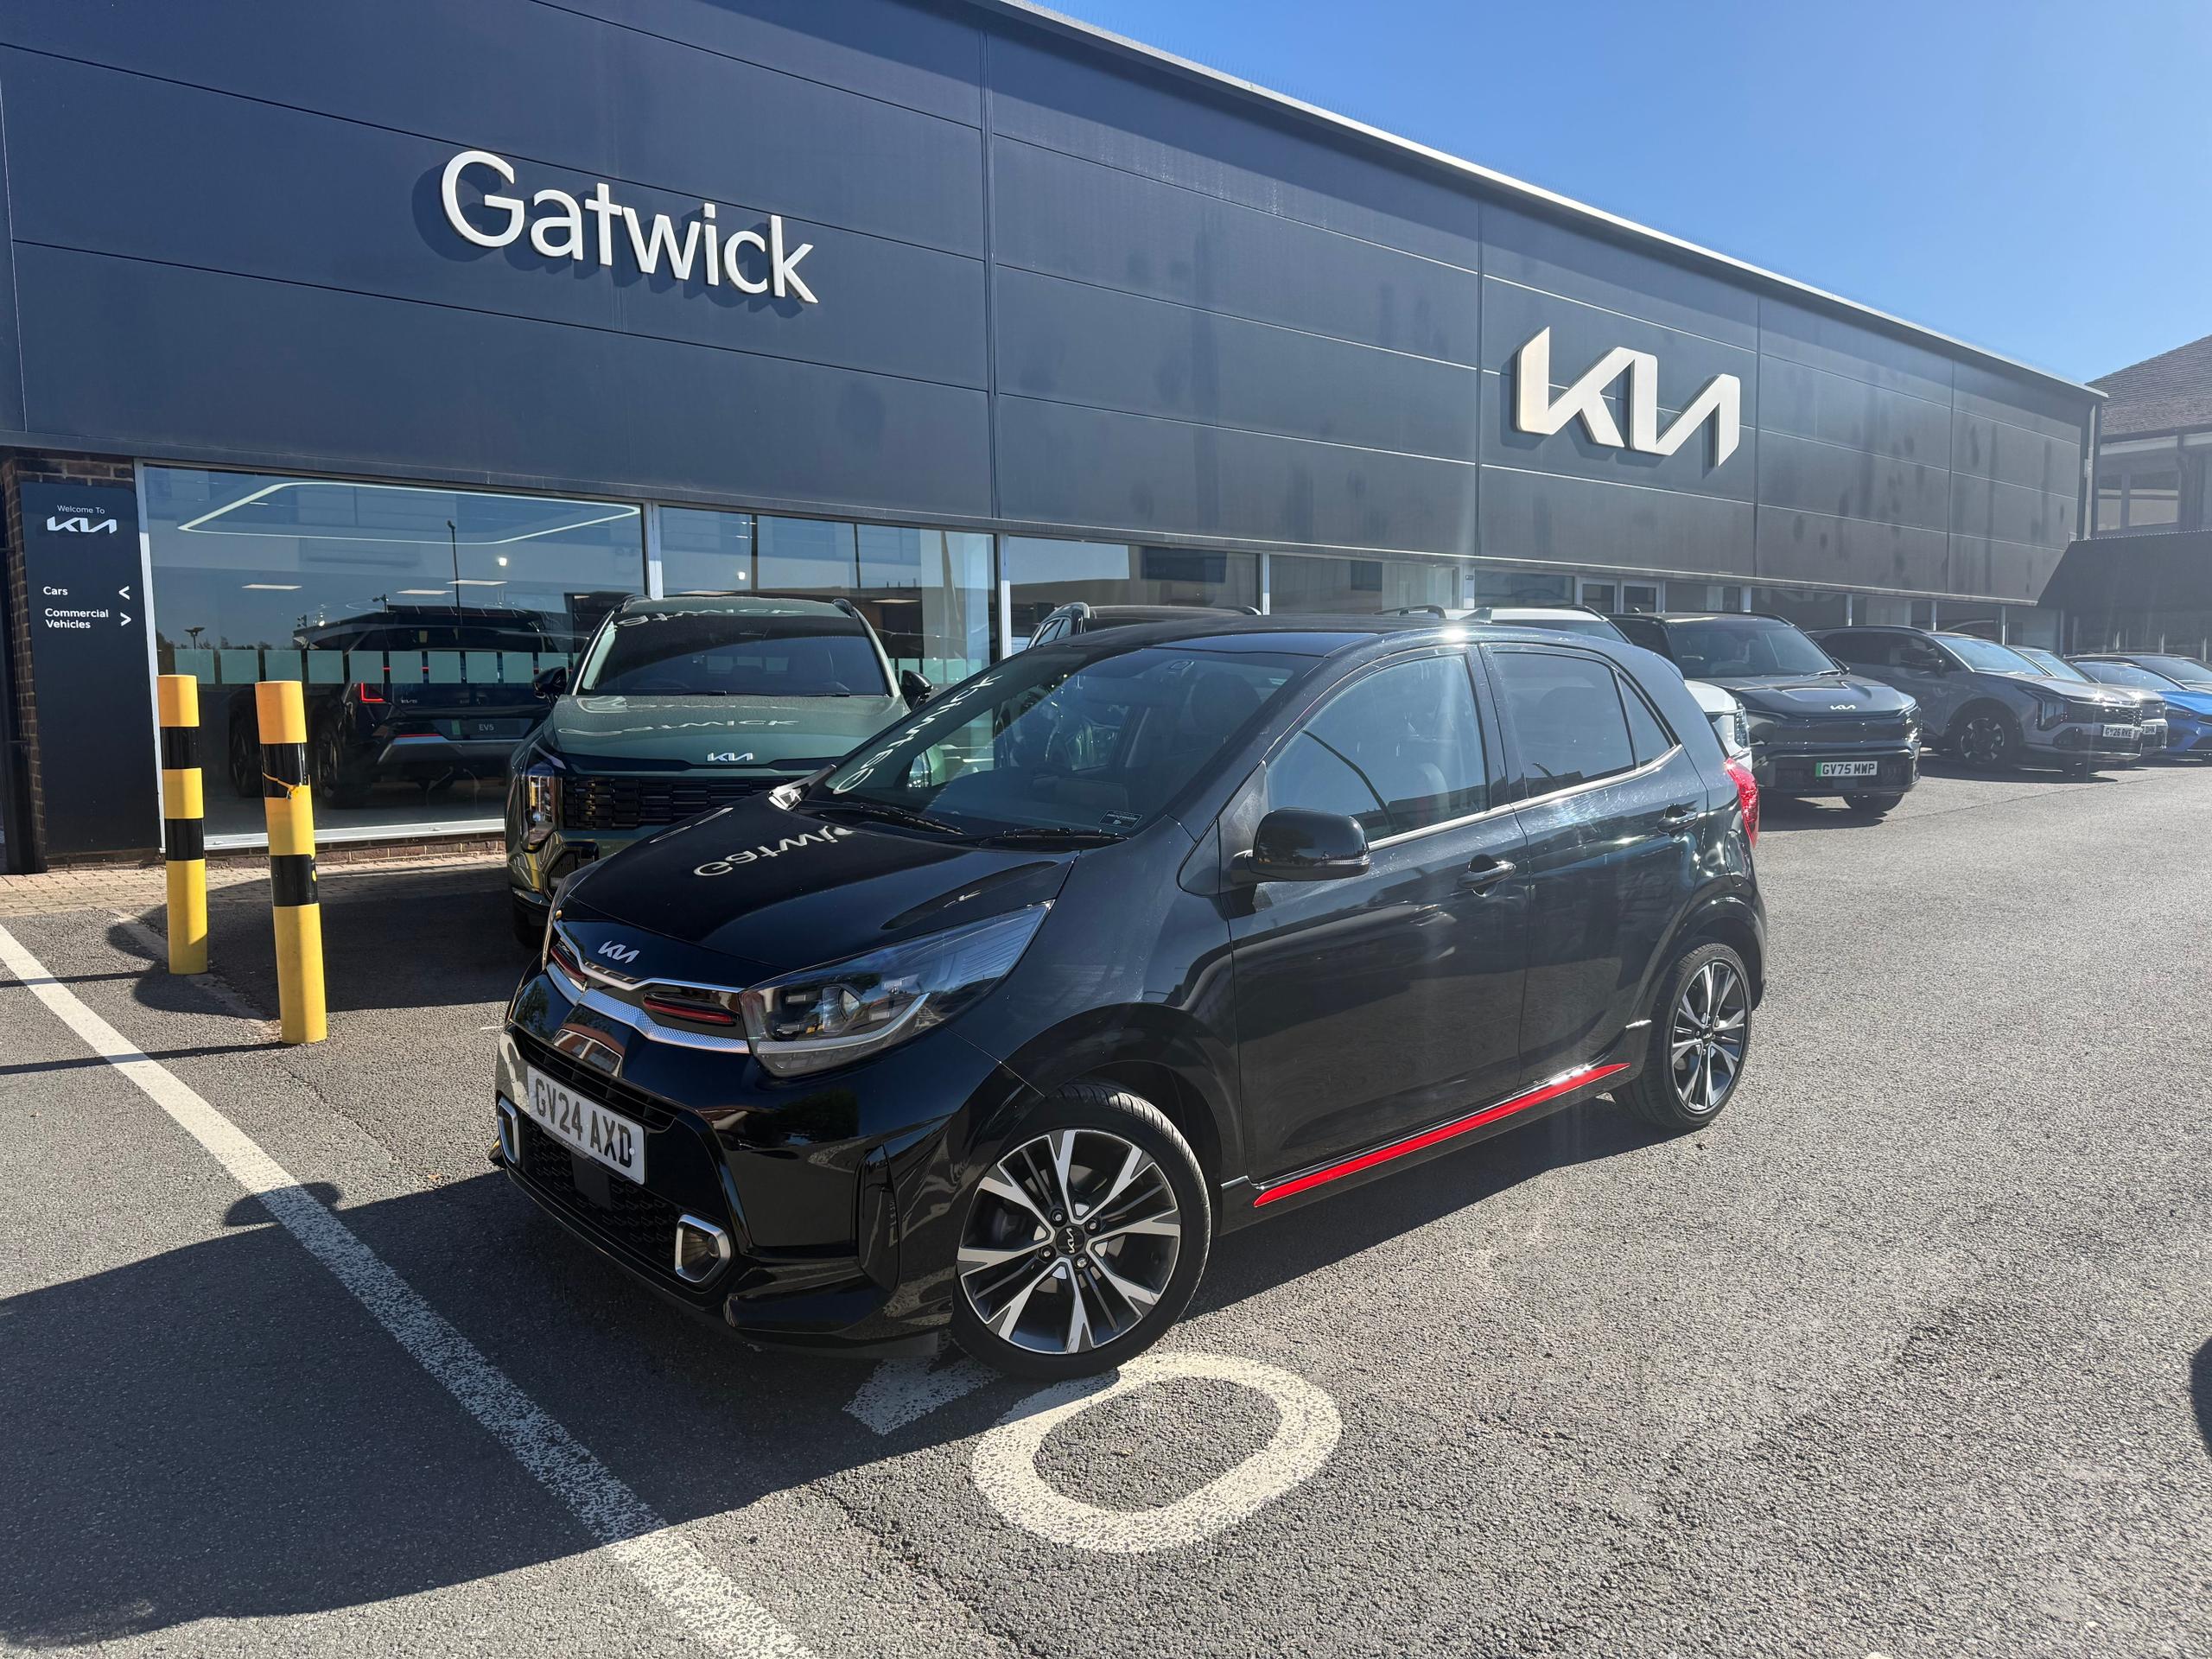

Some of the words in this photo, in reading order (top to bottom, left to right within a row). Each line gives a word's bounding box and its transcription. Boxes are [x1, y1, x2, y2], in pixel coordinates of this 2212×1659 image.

[441, 150, 819, 304] Gatwick
[1516, 326, 1741, 467] KIA
[57, 505, 93, 514] Welcome
[47, 516, 118, 534] KIA
[43, 586, 68, 595] Cars
[45, 607, 109, 618] Commercial
[46, 619, 91, 629] Vehicles
[707, 752, 753, 762] KIA
[1822, 763, 1852, 775] GV75
[1853, 763, 1875, 774] MWP
[597, 940, 640, 963] KIA
[535, 1077, 583, 1141] GV24
[590, 1110, 632, 1168] AXD
[1065, 1227, 1076, 1255] KIA
